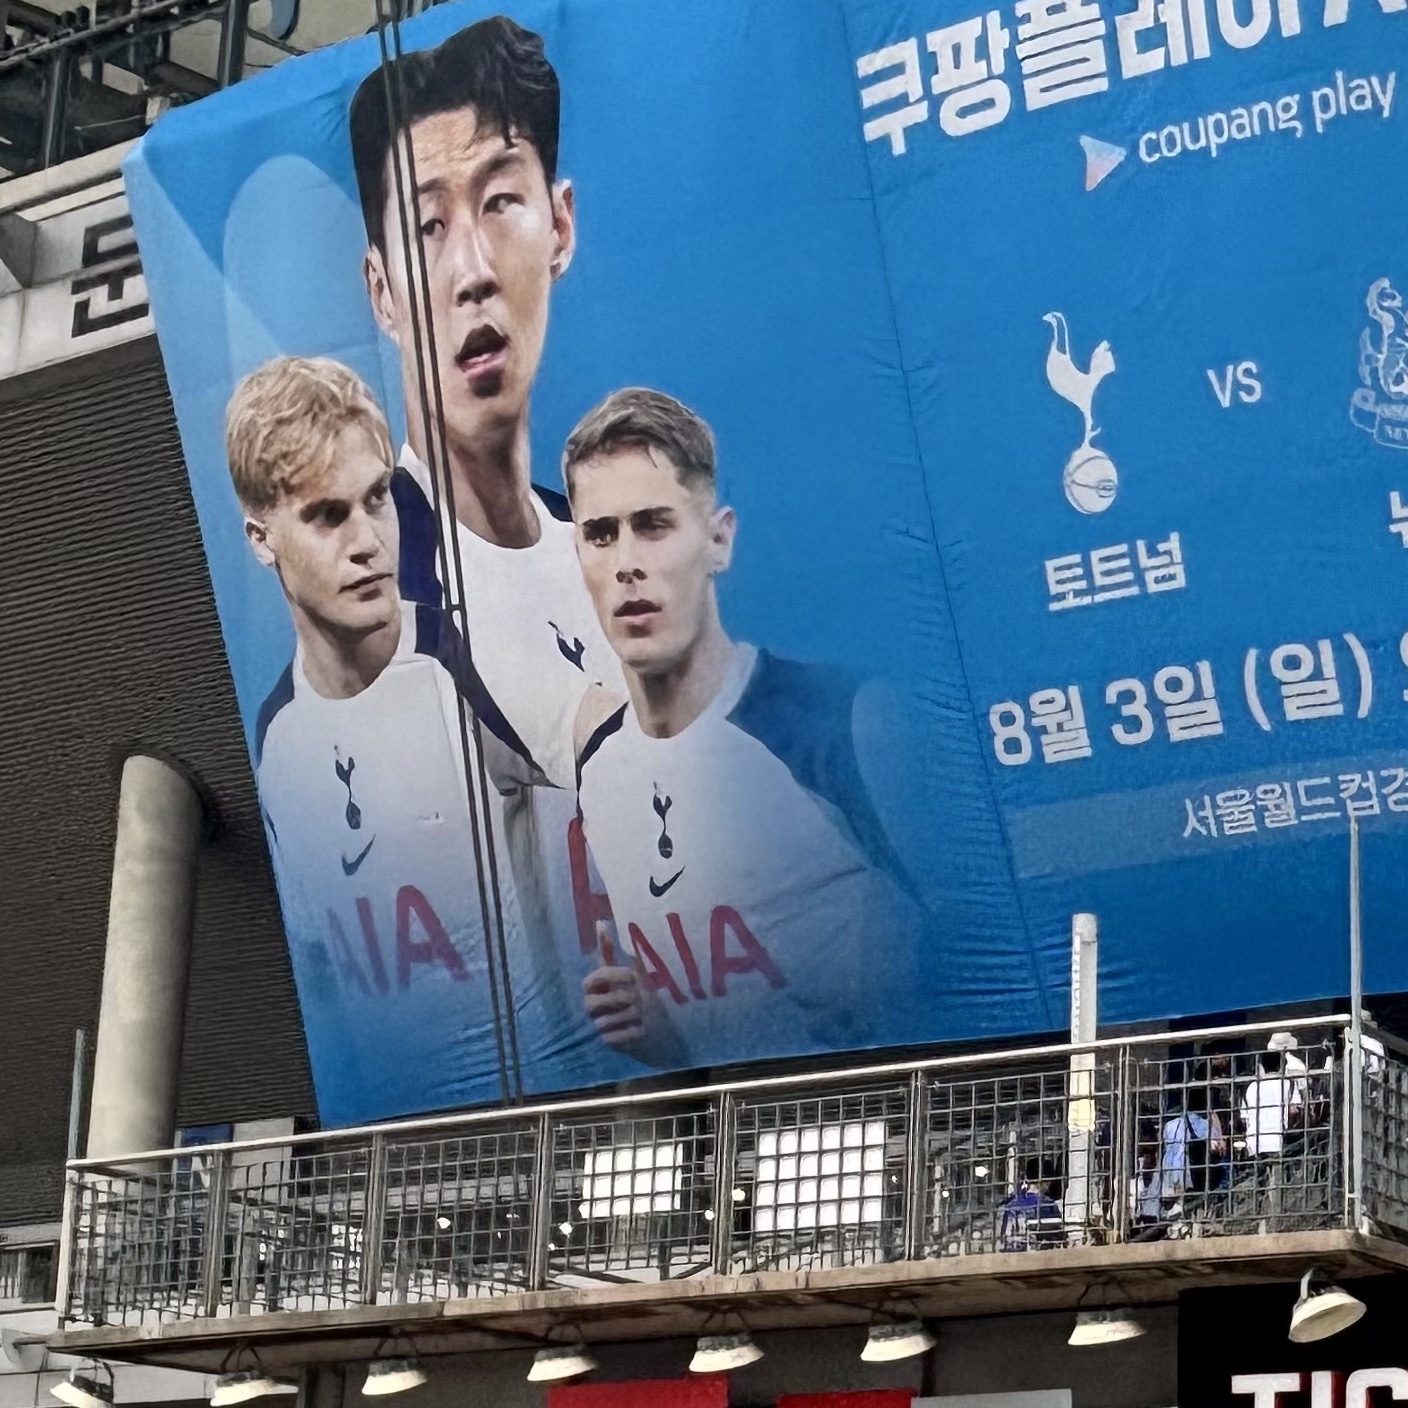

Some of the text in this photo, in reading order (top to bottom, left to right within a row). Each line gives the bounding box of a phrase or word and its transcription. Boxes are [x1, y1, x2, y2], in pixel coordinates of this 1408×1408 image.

[1138, 70, 1396, 163] coupang play
[1206, 361, 1263, 408] VS
[1044, 531, 1187, 611] 토트넘
[988, 685, 1093, 766] 8월
[1105, 660, 1224, 746] 3일
[1243, 633, 1374, 731] (일)
[628, 904, 788, 1005] AIA
